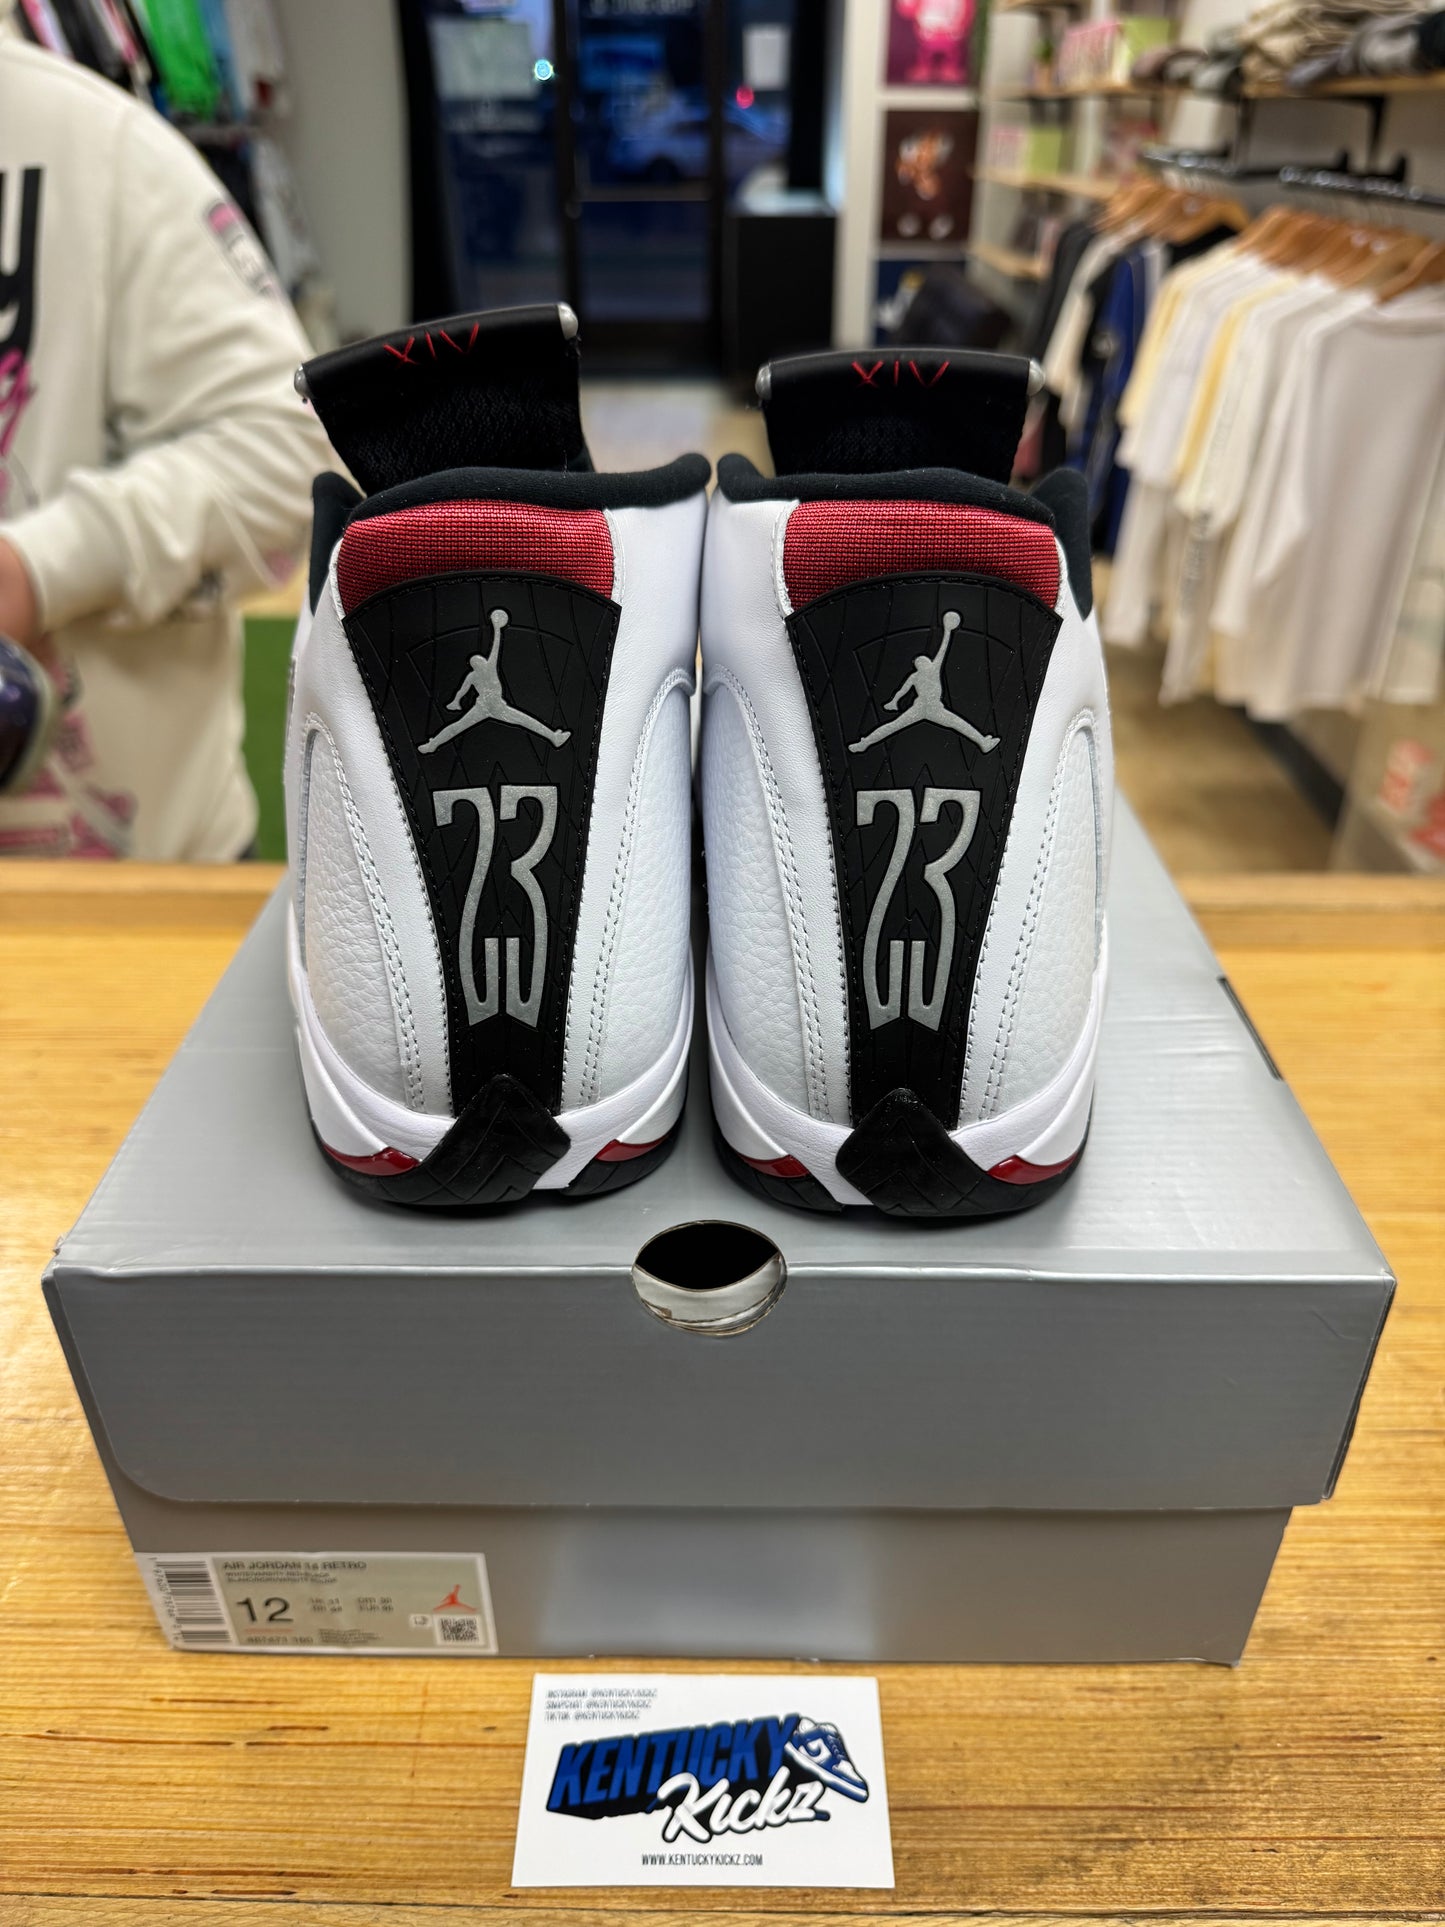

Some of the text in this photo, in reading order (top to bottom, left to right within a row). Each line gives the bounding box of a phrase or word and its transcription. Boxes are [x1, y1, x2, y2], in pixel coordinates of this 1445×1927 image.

[383, 322, 480, 368] XIV
[851, 360, 950, 388] XIV
[432, 784, 558, 1028] 23
[856, 787, 982, 1031] 23
[223, 1560, 246, 1571] AIR
[249, 1560, 301, 1571] JORDAN
[322, 1560, 368, 1570] RETRO
[236, 1596, 295, 1623] 12
[548, 1713, 801, 1811] KENTUCKY
[656, 1765, 827, 1843] Kickz
[641, 1853, 763, 1866] WWW.KENTUCKYKICKZ.COM
